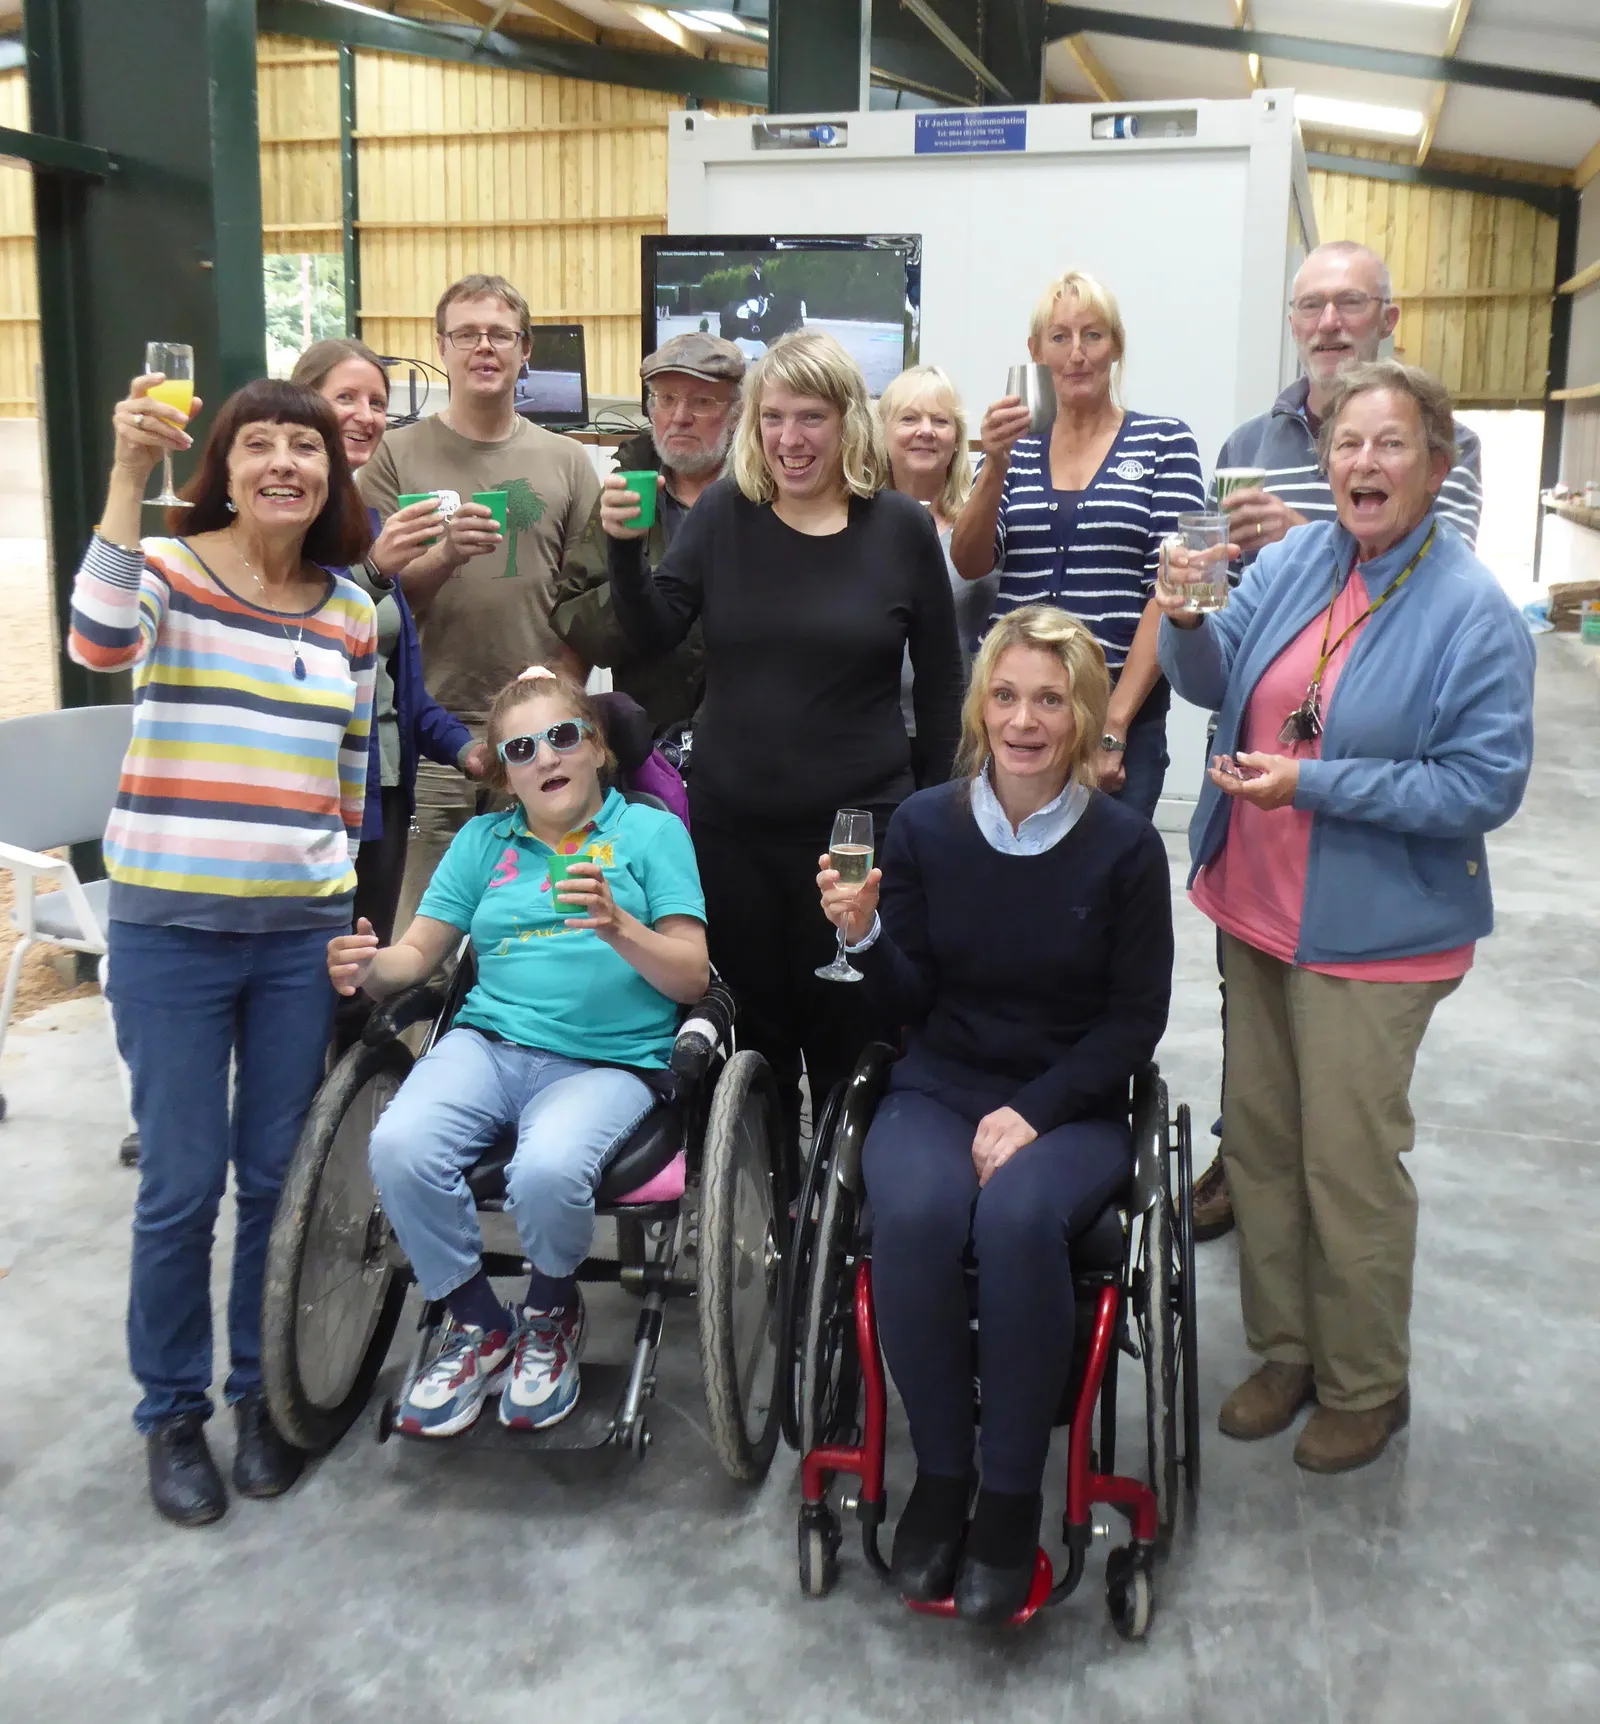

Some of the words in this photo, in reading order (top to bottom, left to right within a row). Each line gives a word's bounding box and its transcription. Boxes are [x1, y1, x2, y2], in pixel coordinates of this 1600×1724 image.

[917, 120, 922, 128] T
[925, 120, 930, 128] F
[931, 119, 962, 128] Jackson
[964, 116, 1025, 127] Accommodation
